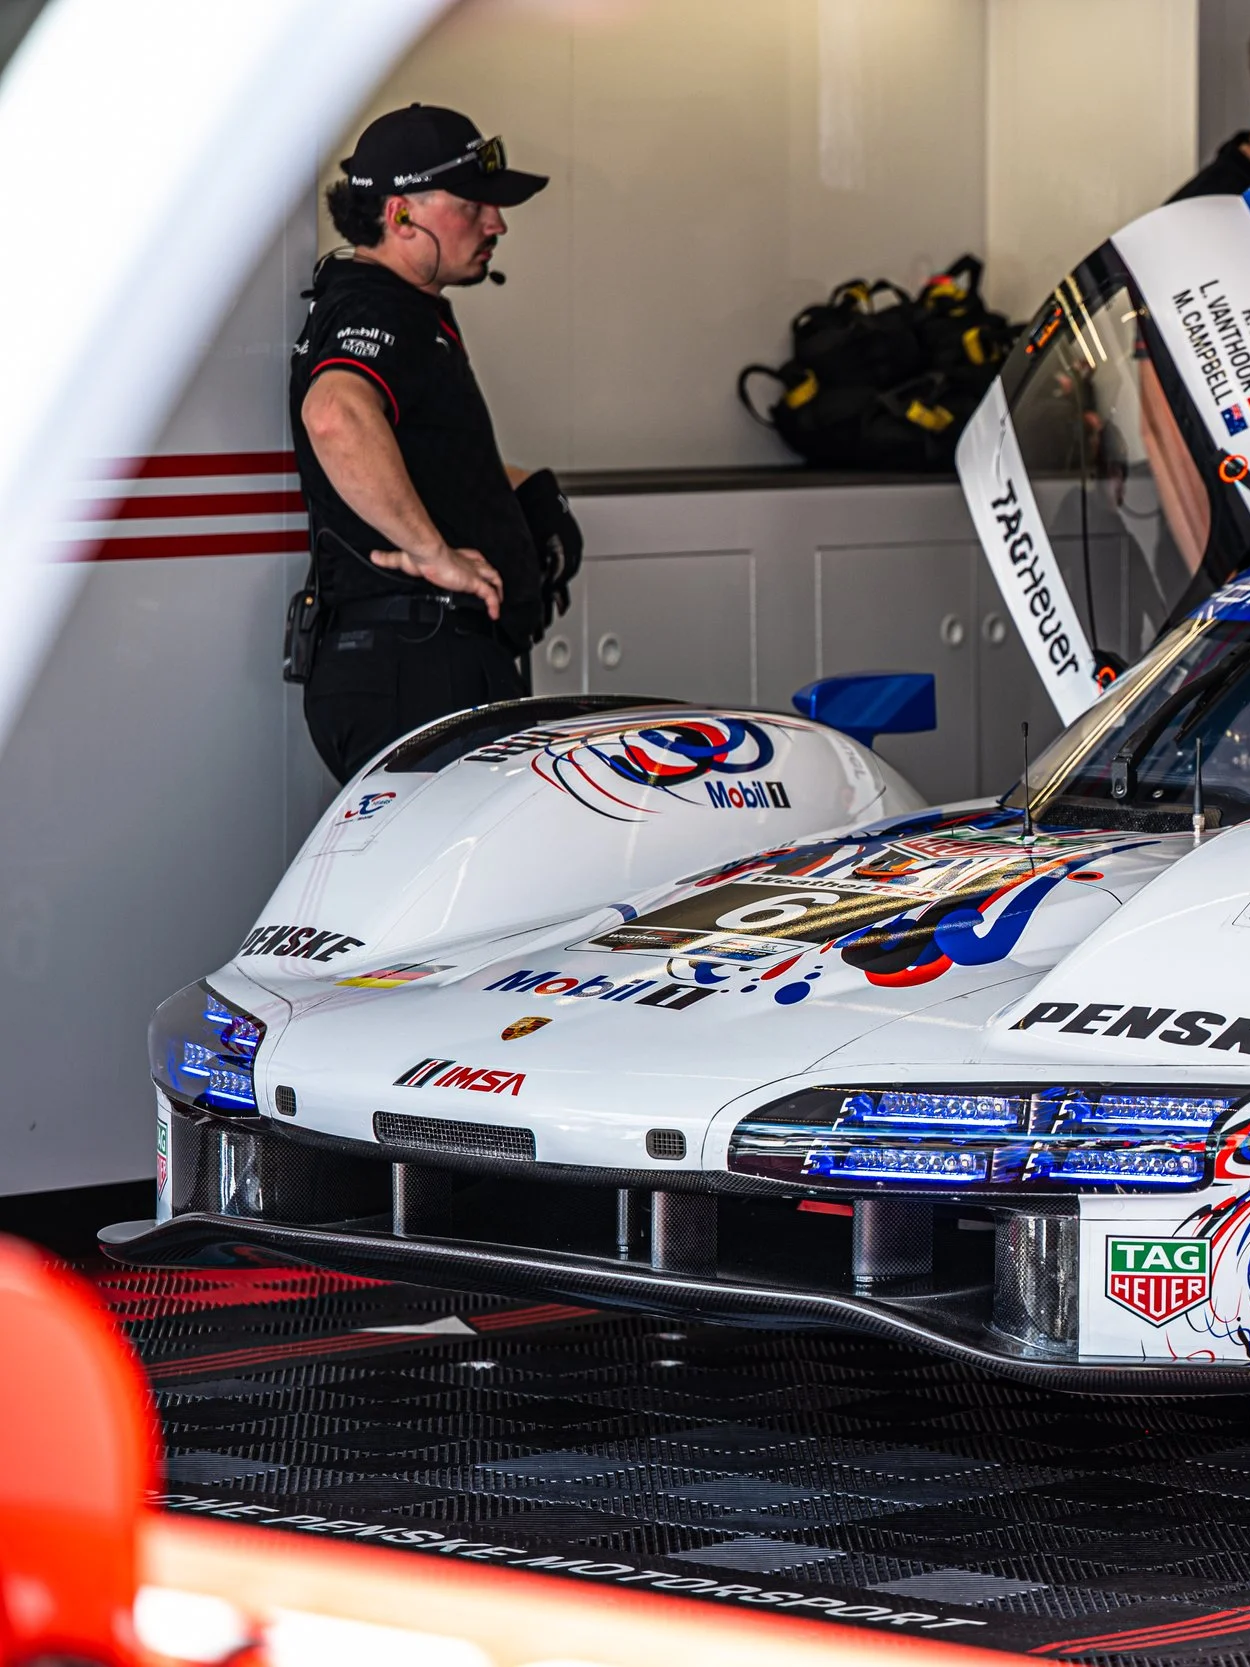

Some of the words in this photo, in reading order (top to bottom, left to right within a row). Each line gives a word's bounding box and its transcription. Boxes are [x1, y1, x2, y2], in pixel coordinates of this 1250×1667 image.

[1172, 289, 1194, 314] M.
[1199, 279, 1219, 298] L.
[1182, 311, 1233, 406] CAMPBELL
[705, 781, 770, 809] Mobil
[749, 875, 940, 899] WeatherTech
[714, 892, 841, 930] 6
[482, 970, 658, 1001] Mobil
[433, 1066, 527, 1097] IMSA
[1117, 1244, 1200, 1270] TAG
[1114, 1276, 1203, 1319] HEUER
[259, 1514, 527, 1559] PENSKE
[508, 1553, 988, 1630] MOTORSPORT
